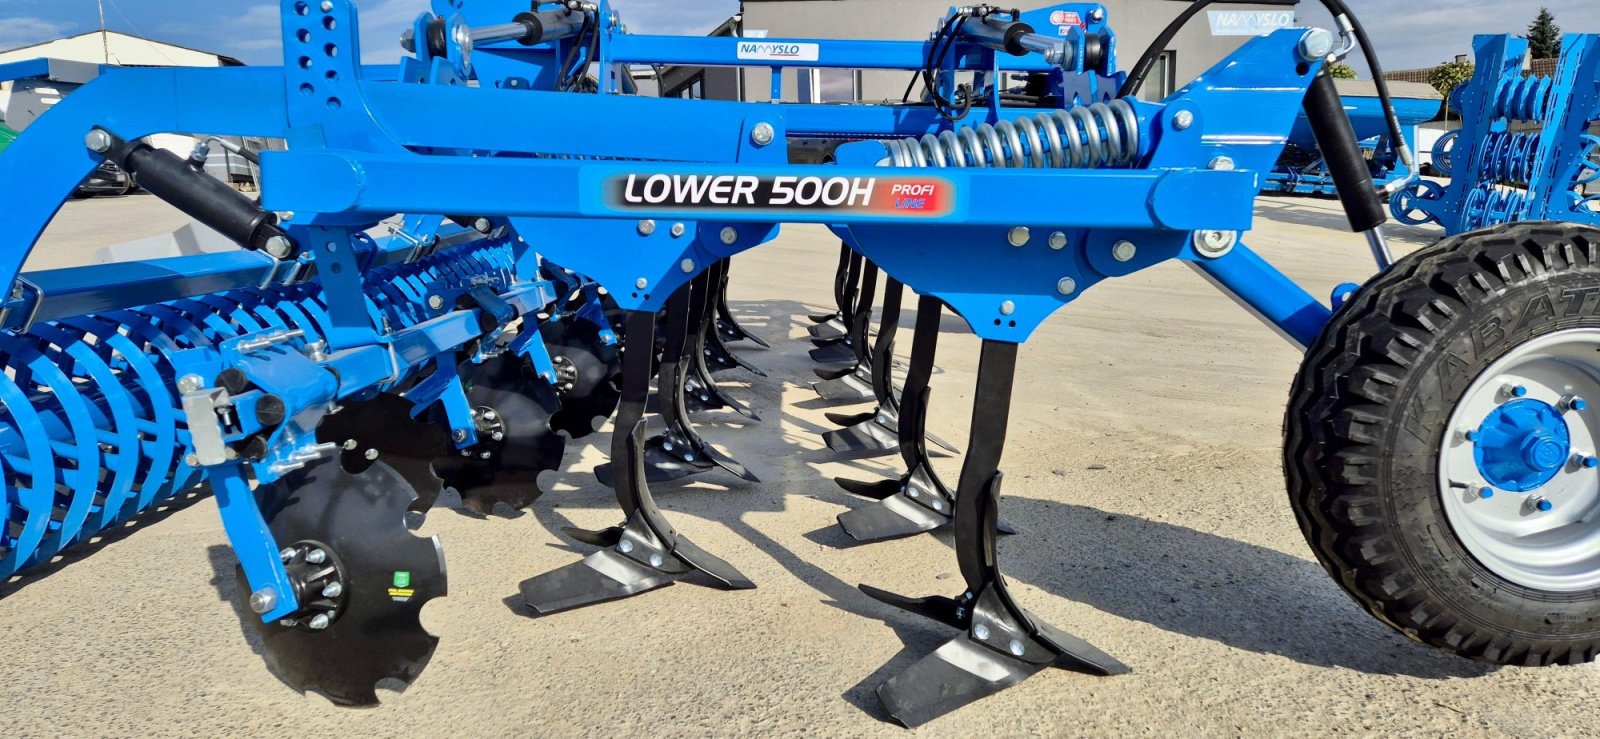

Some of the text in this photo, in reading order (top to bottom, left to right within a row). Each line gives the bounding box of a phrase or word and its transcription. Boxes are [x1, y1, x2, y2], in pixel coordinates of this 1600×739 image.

[624, 173, 876, 206] LOWER 500H
[891, 184, 935, 196] PROFI
[895, 198, 926, 209] LINE
[1404, 286, 1600, 445] KABAT
